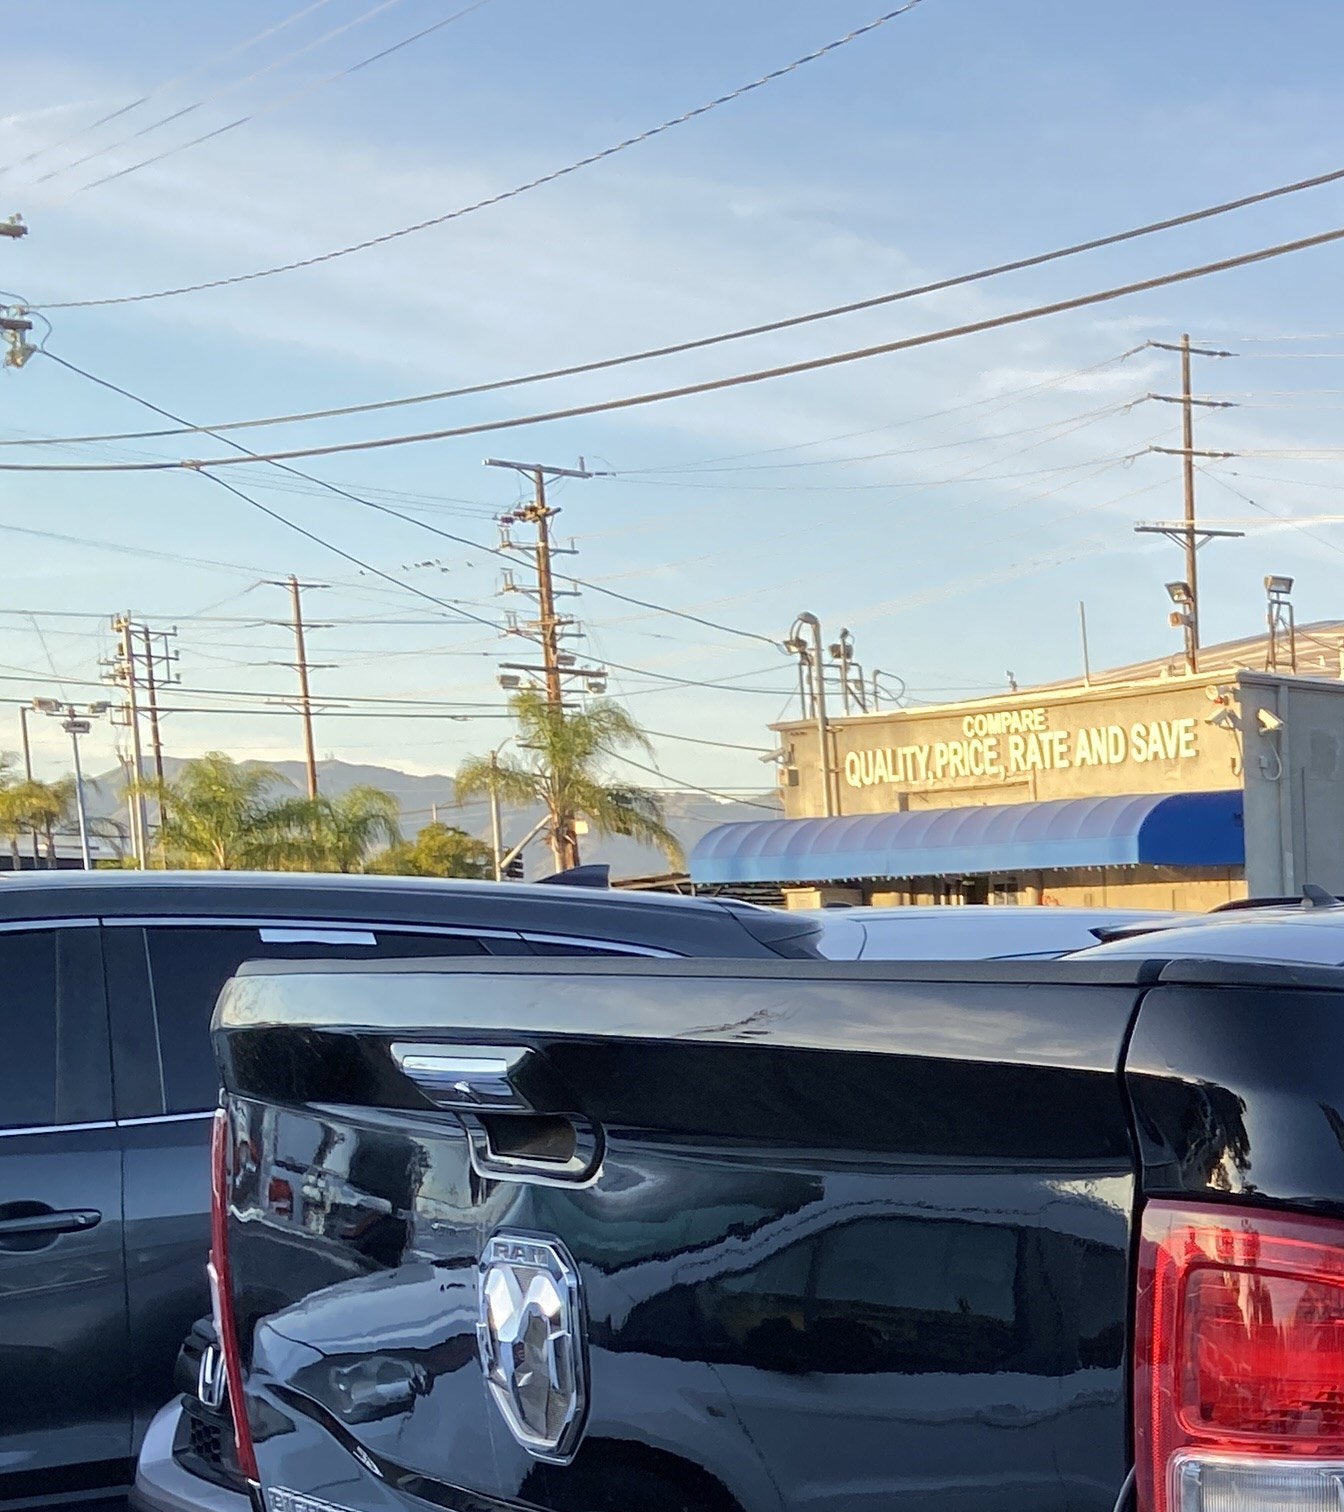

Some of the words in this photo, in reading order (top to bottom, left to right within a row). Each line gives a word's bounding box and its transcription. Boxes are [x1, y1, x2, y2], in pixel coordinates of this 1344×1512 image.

[963, 708, 1046, 738] COMPARE
[845, 744, 934, 788] QUALITY,
[935, 737, 1006, 782] PRICE,
[1008, 730, 1071, 772] RATE
[1074, 725, 1127, 767] AND
[1131, 718, 1198, 763] SAVE
[492, 1242, 550, 1267] RAM
